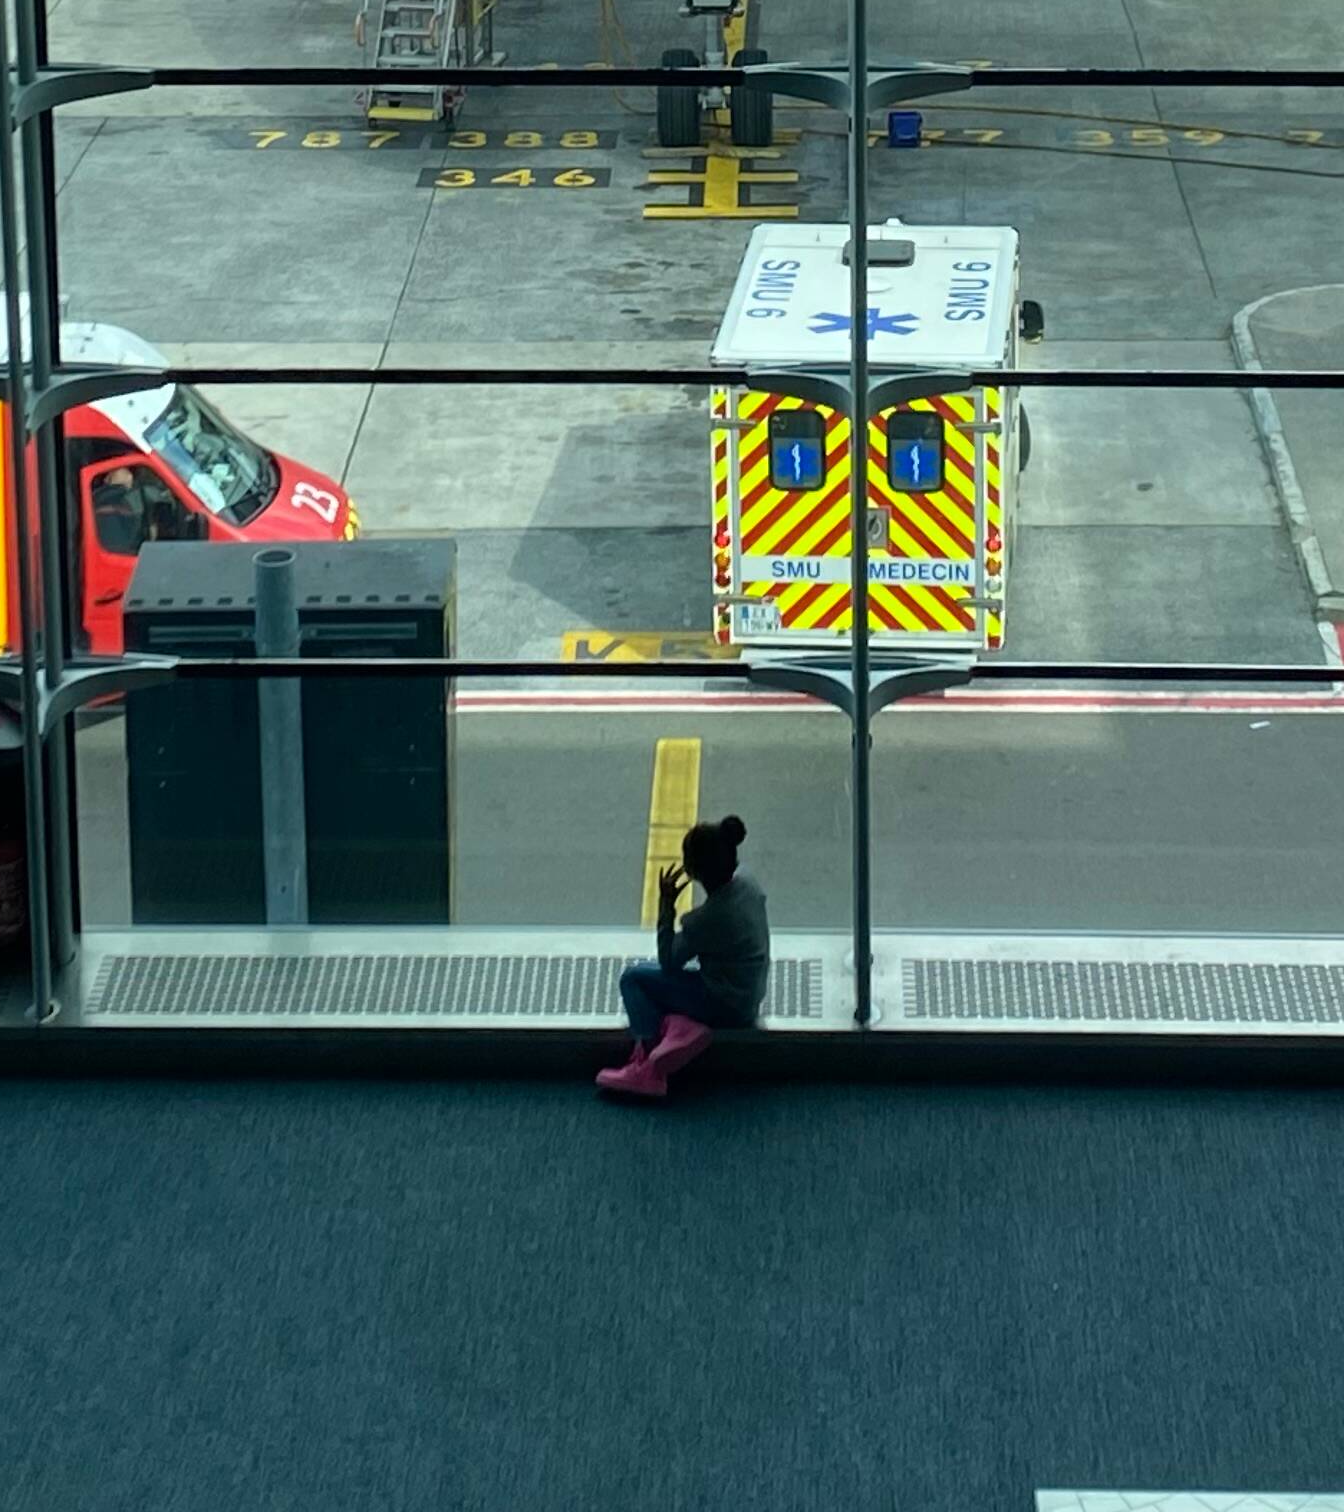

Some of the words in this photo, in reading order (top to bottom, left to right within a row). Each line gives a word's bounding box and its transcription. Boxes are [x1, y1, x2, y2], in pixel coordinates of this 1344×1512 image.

[248, 130, 400, 149] 787
[1073, 128, 1225, 147] 359
[434, 168, 597, 187] 346
[951, 261, 992, 272] 6
[751, 259, 801, 302] SMU
[943, 278, 990, 321] SMU
[745, 307, 787, 318] 6
[290, 481, 340, 524] 23
[771, 560, 821, 578] SMU
[868, 562, 970, 581] MEDECIN
